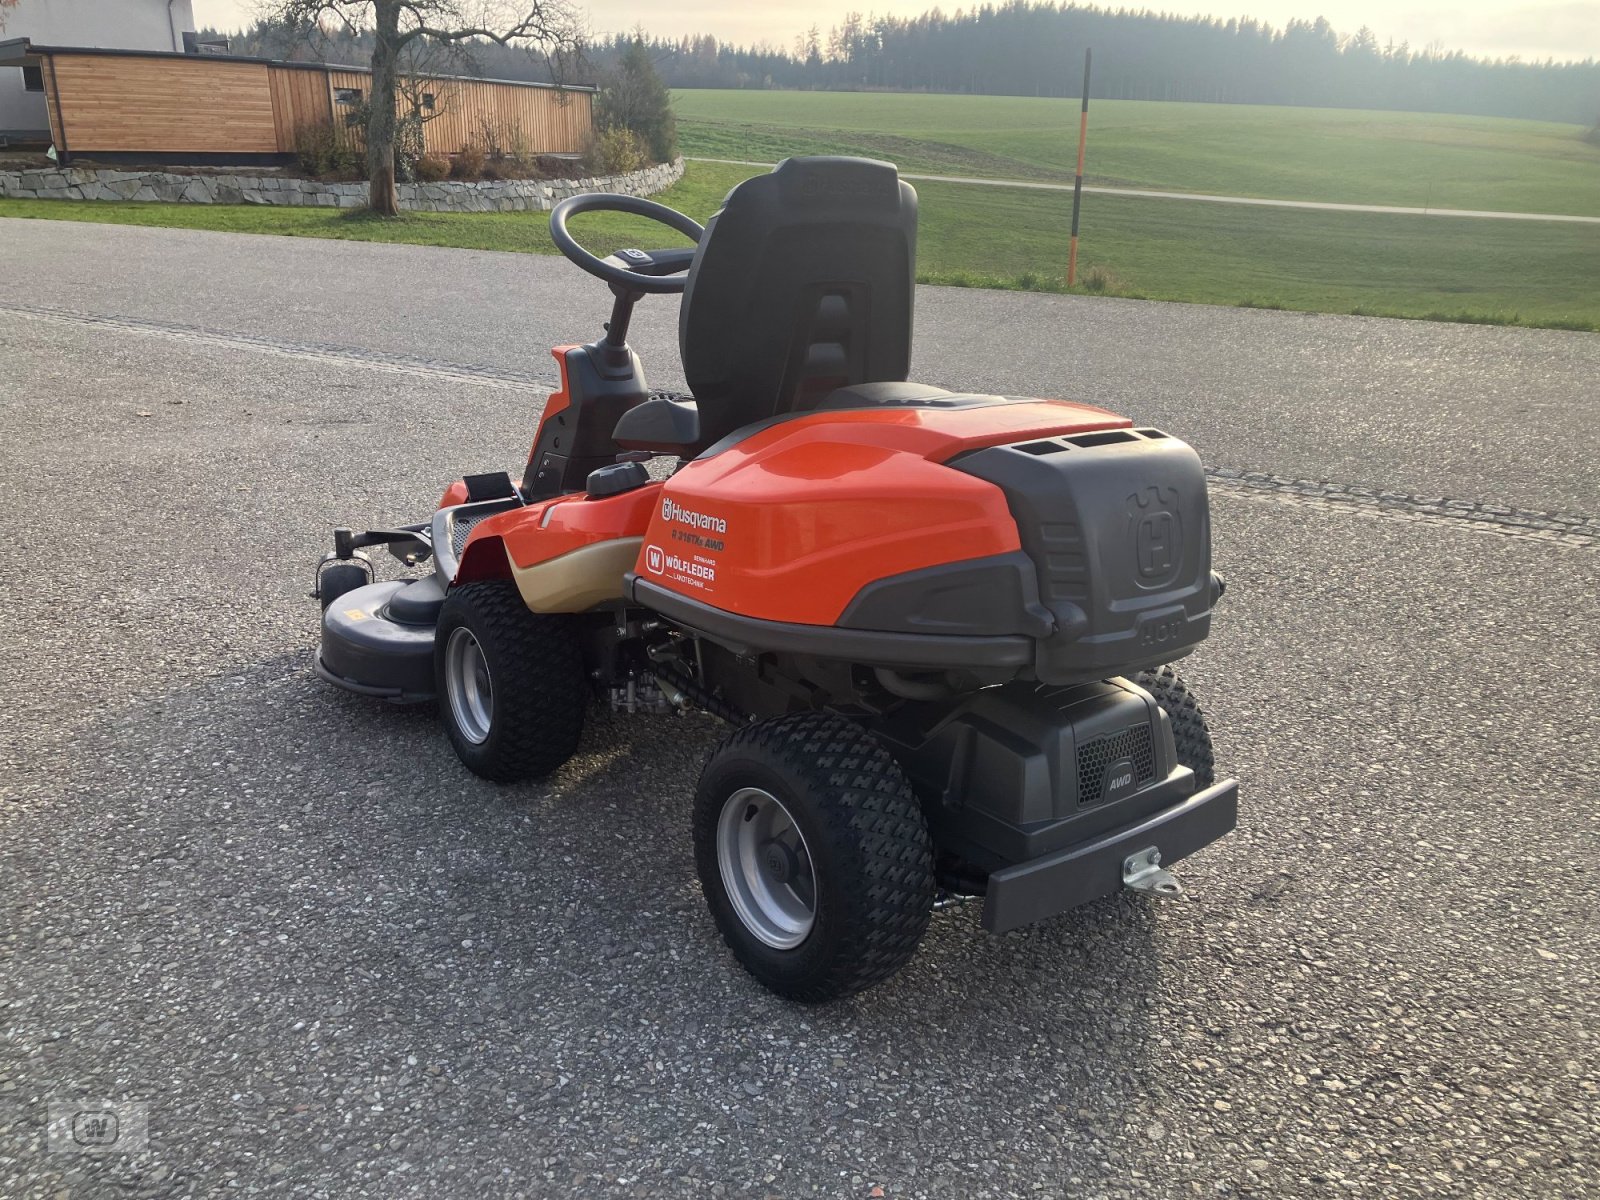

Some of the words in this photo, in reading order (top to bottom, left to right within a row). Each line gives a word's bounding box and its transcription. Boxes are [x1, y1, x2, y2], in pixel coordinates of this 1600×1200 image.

[671, 503, 726, 533] Husqvarna
[704, 538, 725, 551] AWD
[650, 551, 660, 568] W
[665, 554, 715, 581] WÖLFLEDER
[693, 555, 716, 566] BERNHARD
[673, 573, 704, 588] LANDTECHNIK
[1109, 773, 1131, 791] AWD
